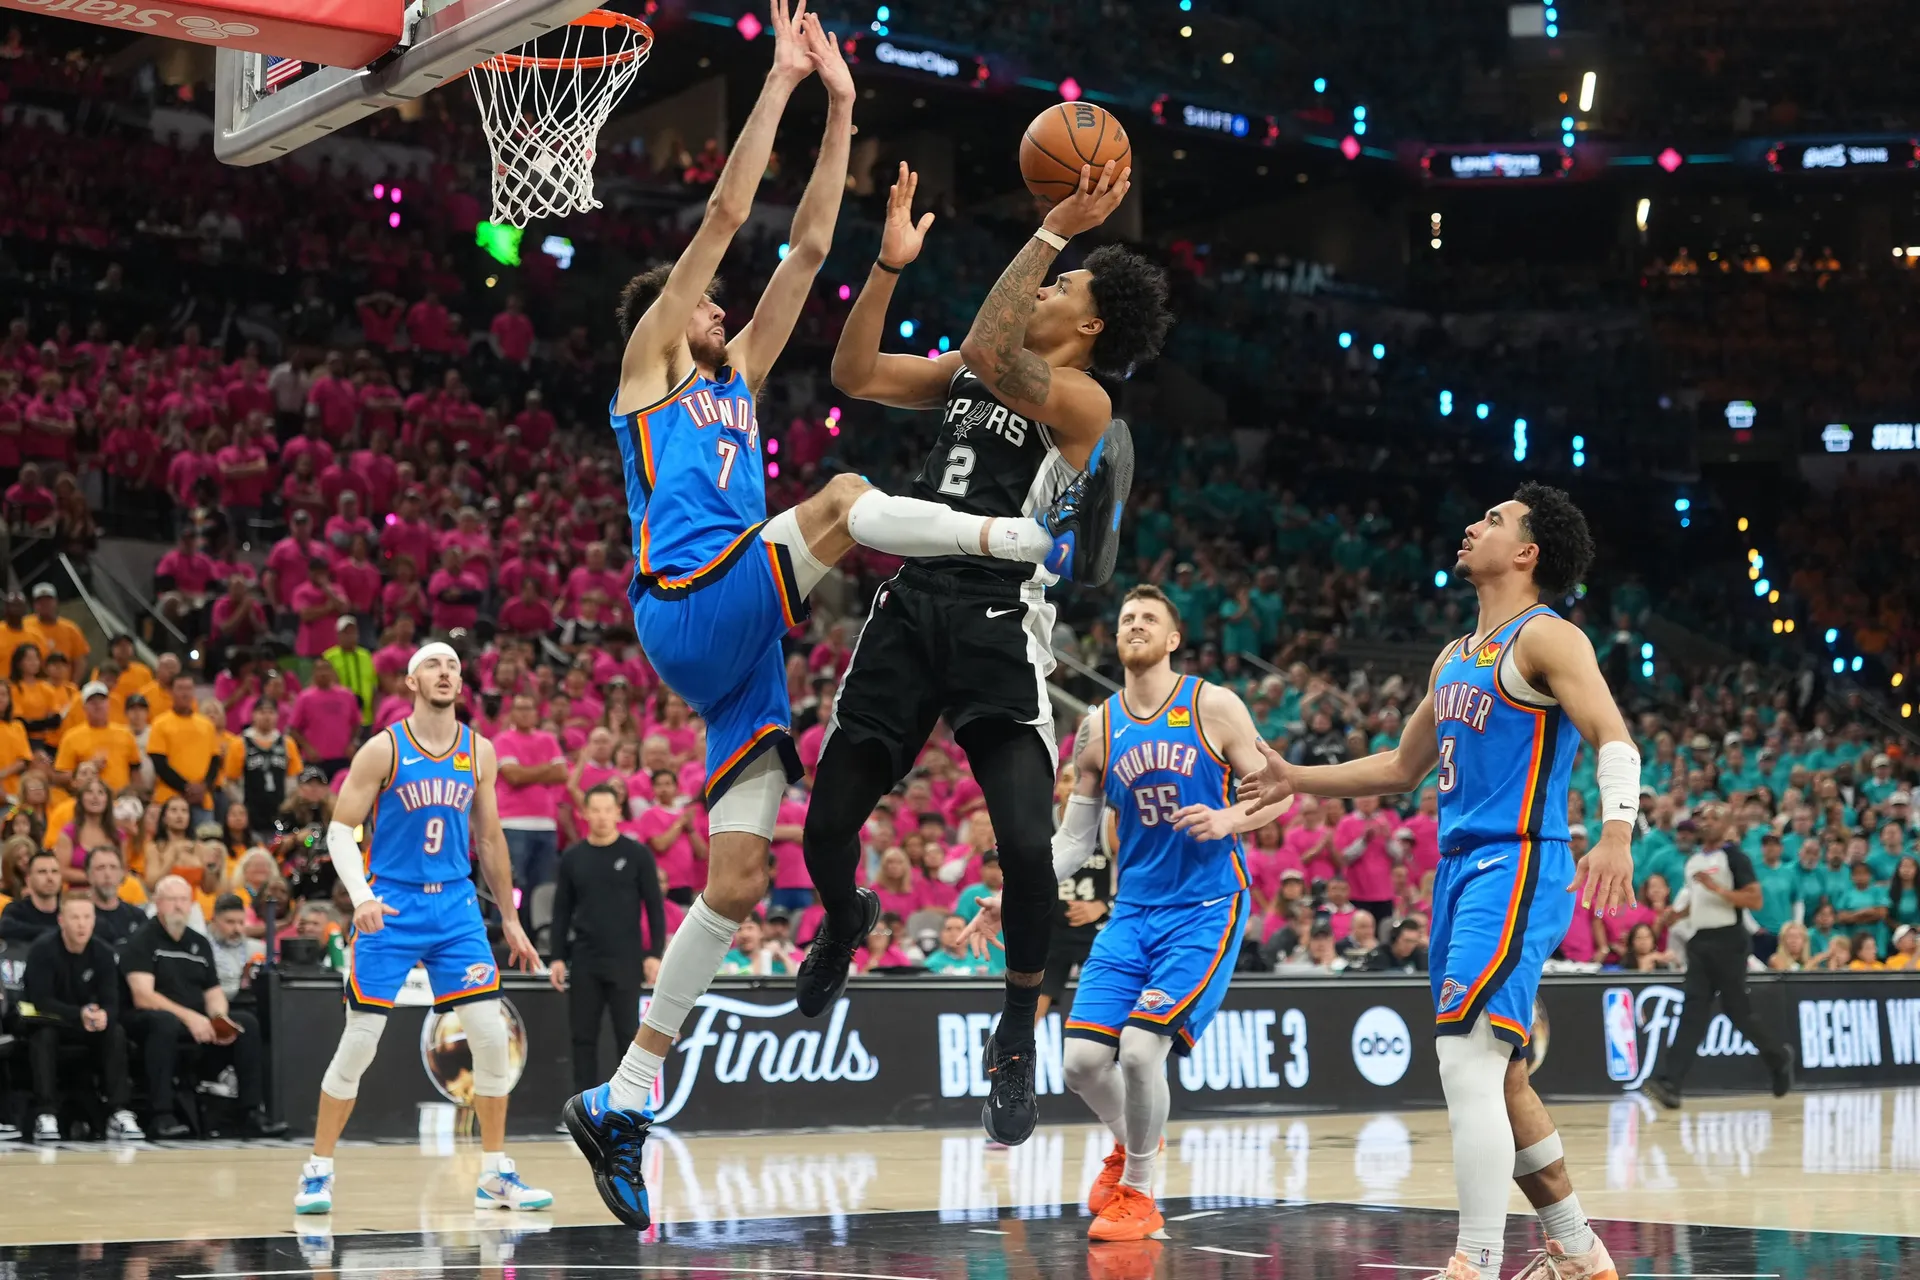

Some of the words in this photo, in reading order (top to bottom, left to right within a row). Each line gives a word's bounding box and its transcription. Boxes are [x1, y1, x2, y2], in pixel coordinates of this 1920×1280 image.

[716, 437, 740, 491] 7
[937, 443, 977, 497] 2
[1112, 740, 1198, 788] THUNDER
[1437, 735, 1457, 793] 3
[396, 777, 475, 813] THUNDER
[1133, 783, 1182, 827] 55
[422, 816, 445, 855] 9
[1057, 877, 1095, 901] 24
[654, 992, 879, 1125] Finals
[937, 1011, 1065, 1098] BEN
[1178, 1009, 1280, 1091] JUNE
[1281, 1007, 1310, 1088] 3
[1359, 1031, 1404, 1055] abc
[1798, 998, 1882, 1069] BEGIN
